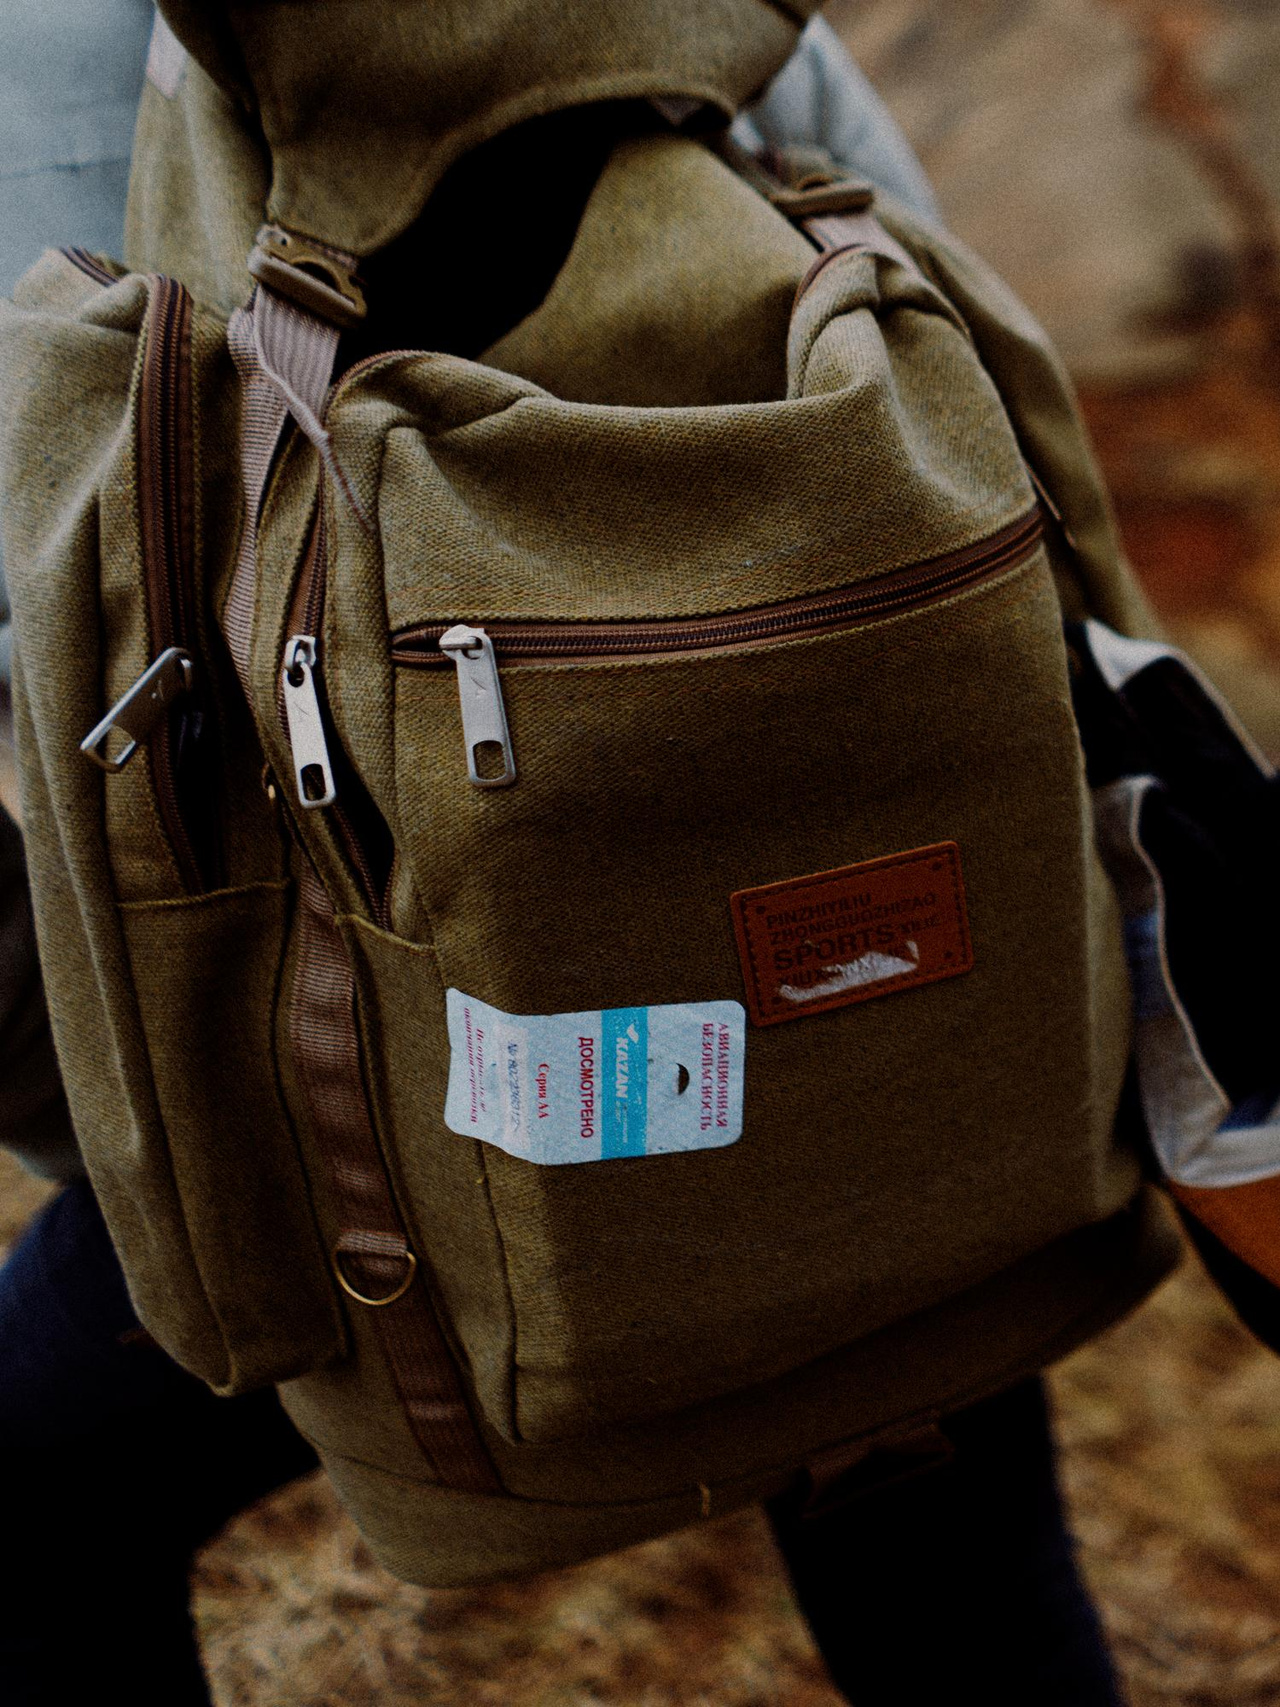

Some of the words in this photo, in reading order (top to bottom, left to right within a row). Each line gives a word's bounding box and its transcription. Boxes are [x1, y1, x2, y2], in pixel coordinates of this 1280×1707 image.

[773, 924, 896, 970] SPORTS
[535, 1062, 550, 1098] Серия
[578, 1036, 594, 1139] ДОСМОТРЕНО
[616, 1037, 629, 1099] KAZAN
[701, 1022, 714, 1130] БЕЗОПАСНОСТЬ
[716, 1022, 730, 1127] АВИАЦИОННАЯ
[538, 1102, 550, 1119] АА
